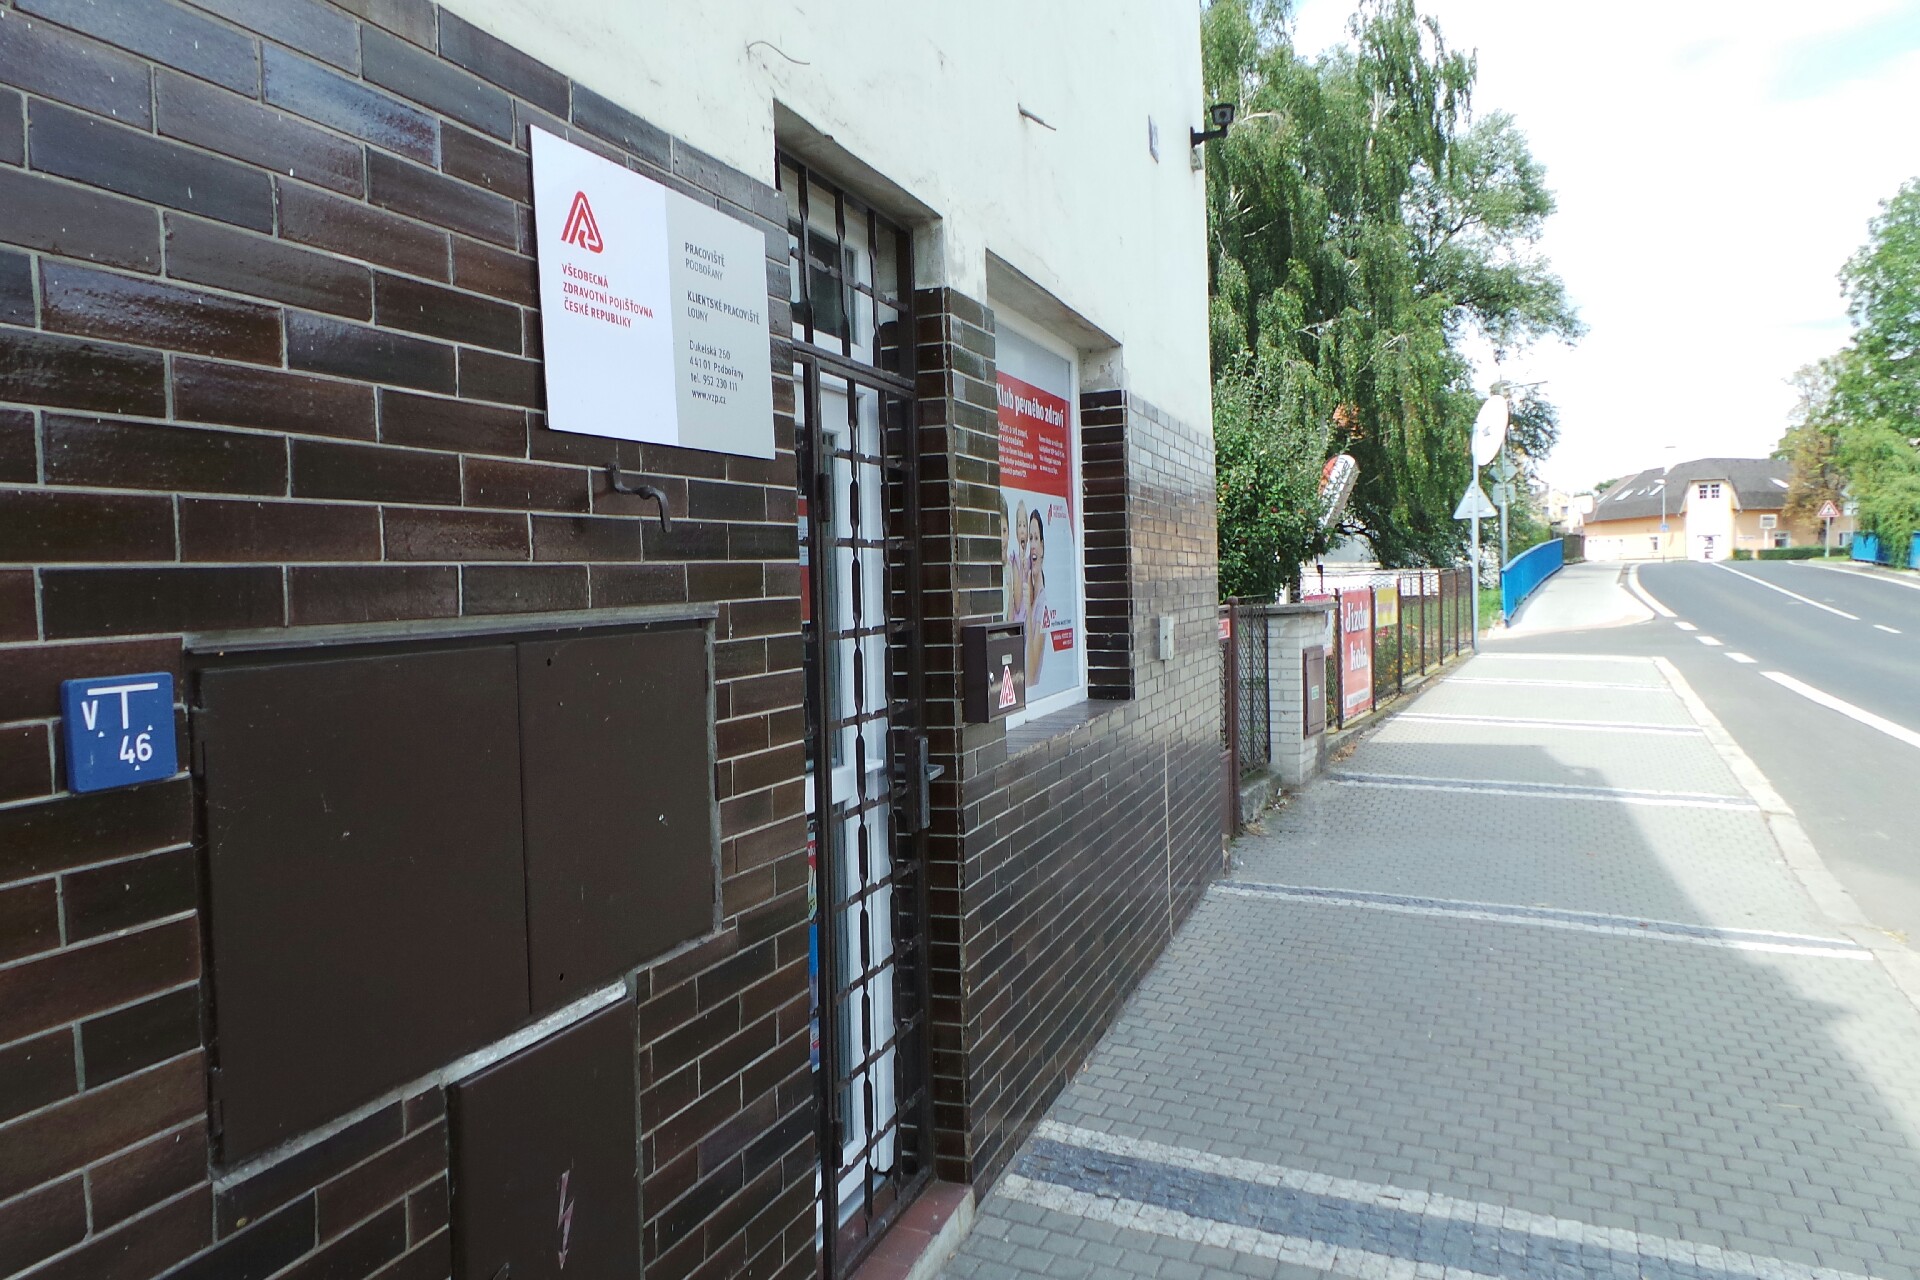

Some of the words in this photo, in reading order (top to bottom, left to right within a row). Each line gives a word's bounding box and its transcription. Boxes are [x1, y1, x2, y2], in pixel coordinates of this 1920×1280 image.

[685, 242, 725, 267] PRACOVIŠTĚ
[561, 263, 609, 289] VŠEOBECNÁ
[685, 258, 723, 281] PODBOŘANY
[563, 281, 608, 305] ZDRAVOTNÍ
[609, 295, 654, 319] POJIŠŤOVNA
[564, 296, 589, 316] ČESKÉ
[591, 307, 632, 329] REPUBLIKY
[687, 290, 722, 312] KLIENTSKÉ
[723, 303, 760, 325] PRACOVIŠTĚ
[687, 306, 709, 323] LOUNY
[703, 374, 714, 386] 952
[996, 382, 1014, 410] Klub
[1015, 395, 1044, 420] pevného
[1044, 403, 1064, 428] zdraví
